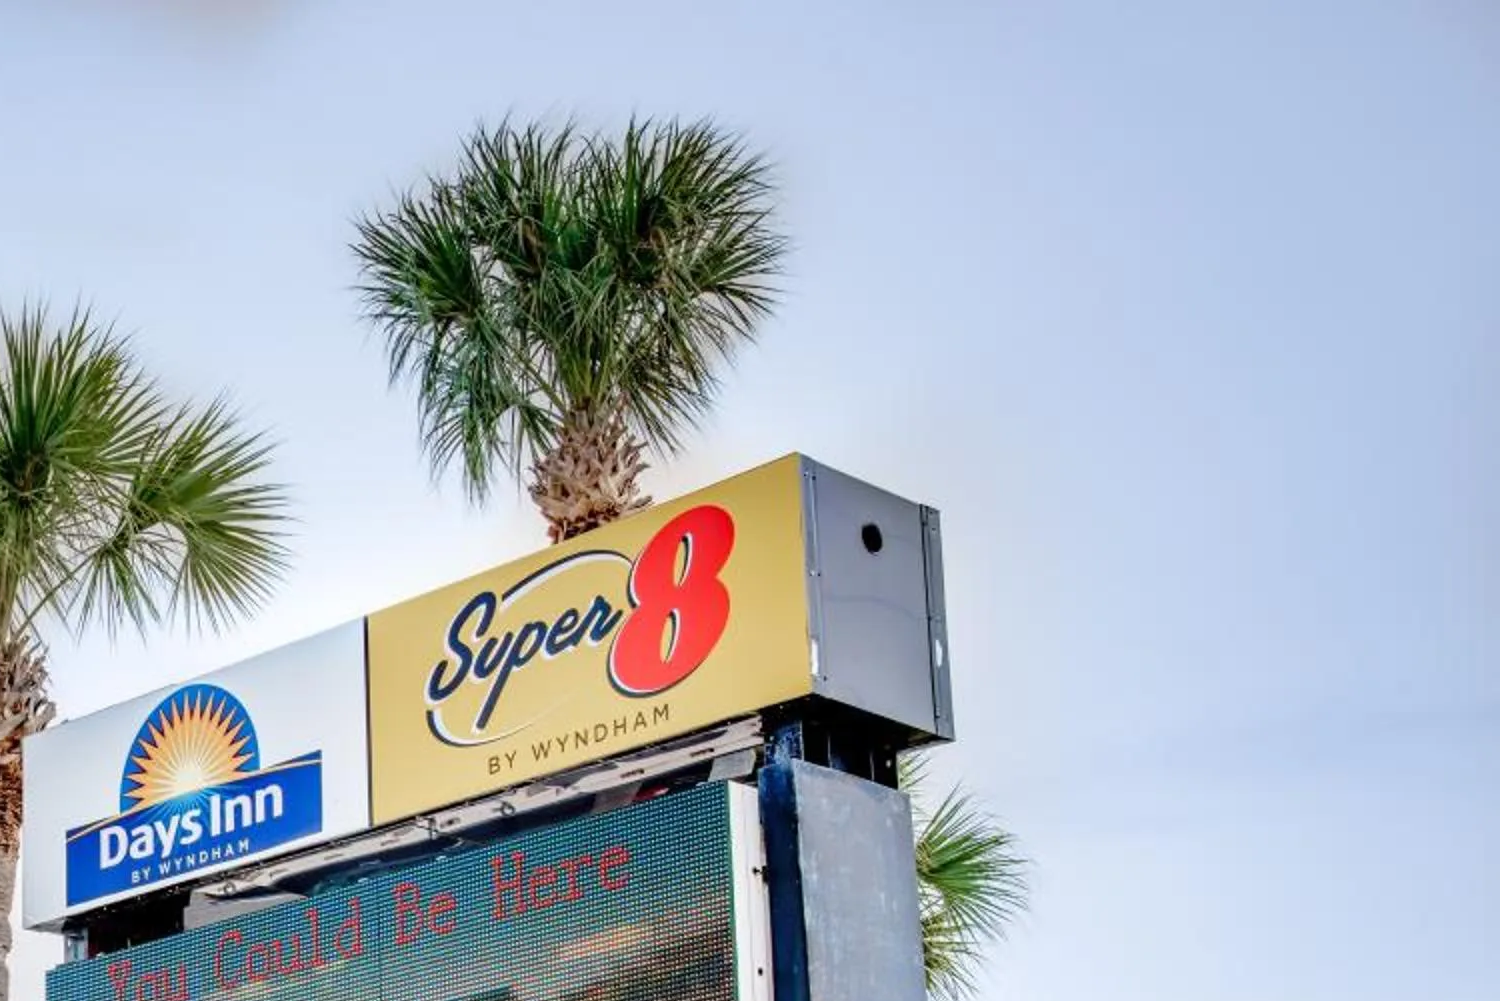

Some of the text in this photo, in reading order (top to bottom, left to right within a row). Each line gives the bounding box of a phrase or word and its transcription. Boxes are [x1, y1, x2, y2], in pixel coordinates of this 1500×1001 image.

[429, 504, 736, 730] Super 8
[488, 703, 670, 776] BY WYNDHAM
[100, 783, 283, 869] Days Inn
[131, 839, 250, 884] BY WYNDHAM
[215, 896, 363, 991] Could
[394, 882, 457, 945] Be
[491, 846, 631, 920] Here
